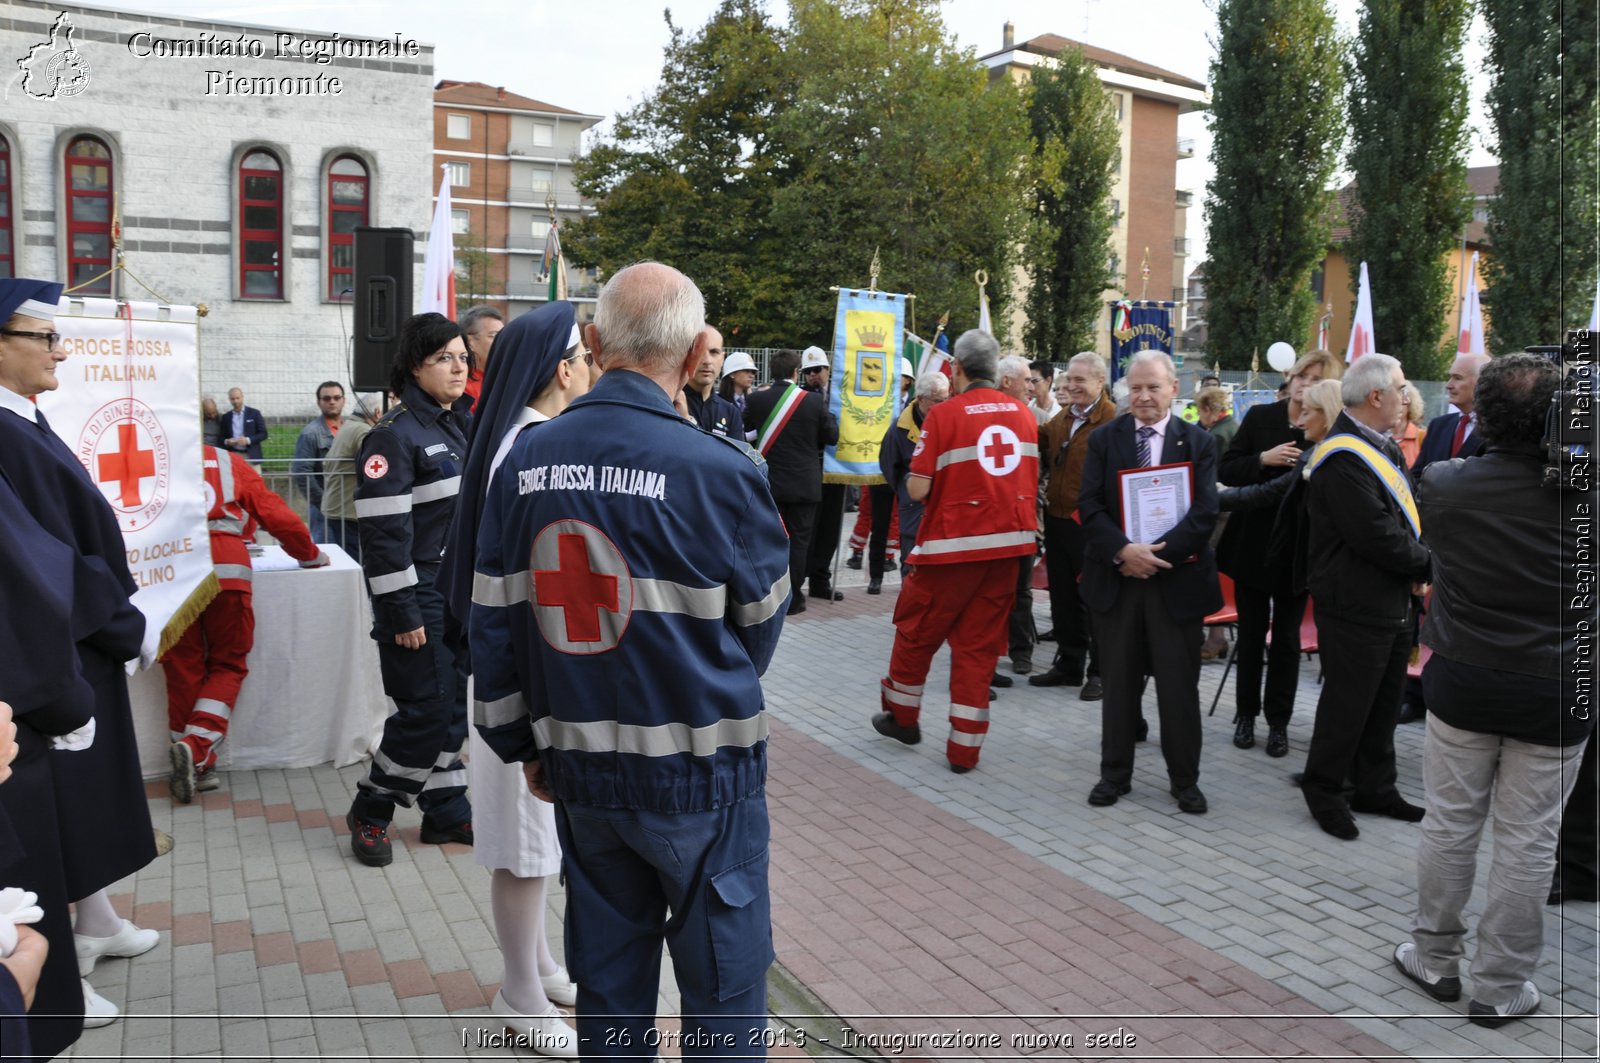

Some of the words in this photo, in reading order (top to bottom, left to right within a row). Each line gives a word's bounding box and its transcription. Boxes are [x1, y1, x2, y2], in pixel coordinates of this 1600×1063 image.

[62, 337, 122, 356] CROCE
[128, 340, 172, 357] ROSSA
[84, 365, 157, 382] ITALIANA
[518, 465, 548, 495] CROCE
[550, 464, 595, 492] ROSSA
[600, 466, 666, 501] ITALIANA
[143, 537, 194, 561] LOCALE
